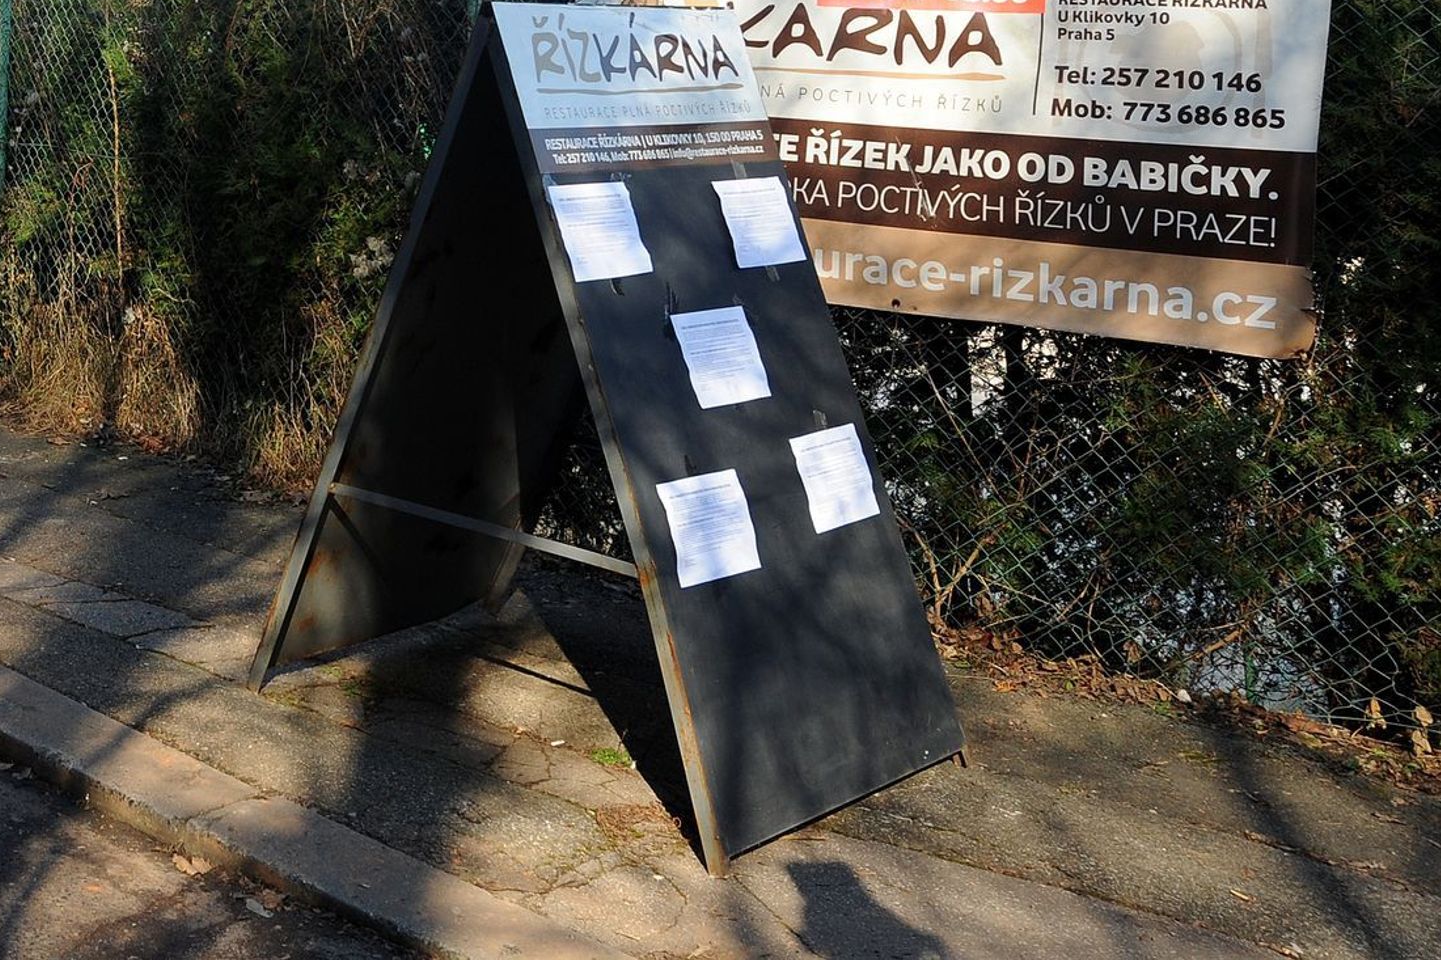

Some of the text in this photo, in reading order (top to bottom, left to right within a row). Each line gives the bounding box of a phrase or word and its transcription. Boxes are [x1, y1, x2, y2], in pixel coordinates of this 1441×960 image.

[1058, 10, 1171, 28] U Klikovky 10
[531, 11, 739, 83] ŘÍZKÁRNA
[1057, 28, 1115, 41] Praha 5
[1054, 65, 1262, 93] Tel: 257 210 146
[543, 106, 616, 121] RESTAURACE
[655, 100, 715, 117] POCTIVÝCH
[797, 84, 923, 109] POCTIVÝCH
[937, 93, 1003, 114] ŘÍZKŮ
[1050, 97, 1286, 130] Mob: 773 686 865
[544, 136, 599, 151] RESTAURACE
[598, 132, 642, 148] ŘÍZKÁRNA
[731, 129, 757, 142] PRAHA
[772, 127, 1279, 202] E ŘÍZEK JAKO OD BABIČKY.
[787, 176, 830, 207] KA
[836, 180, 1005, 224] POCTIVÝCH
[1014, 188, 1111, 234] ŘÍZKŮ
[1120, 205, 1145, 236] V
[1153, 207, 1277, 248] PRAZE!
